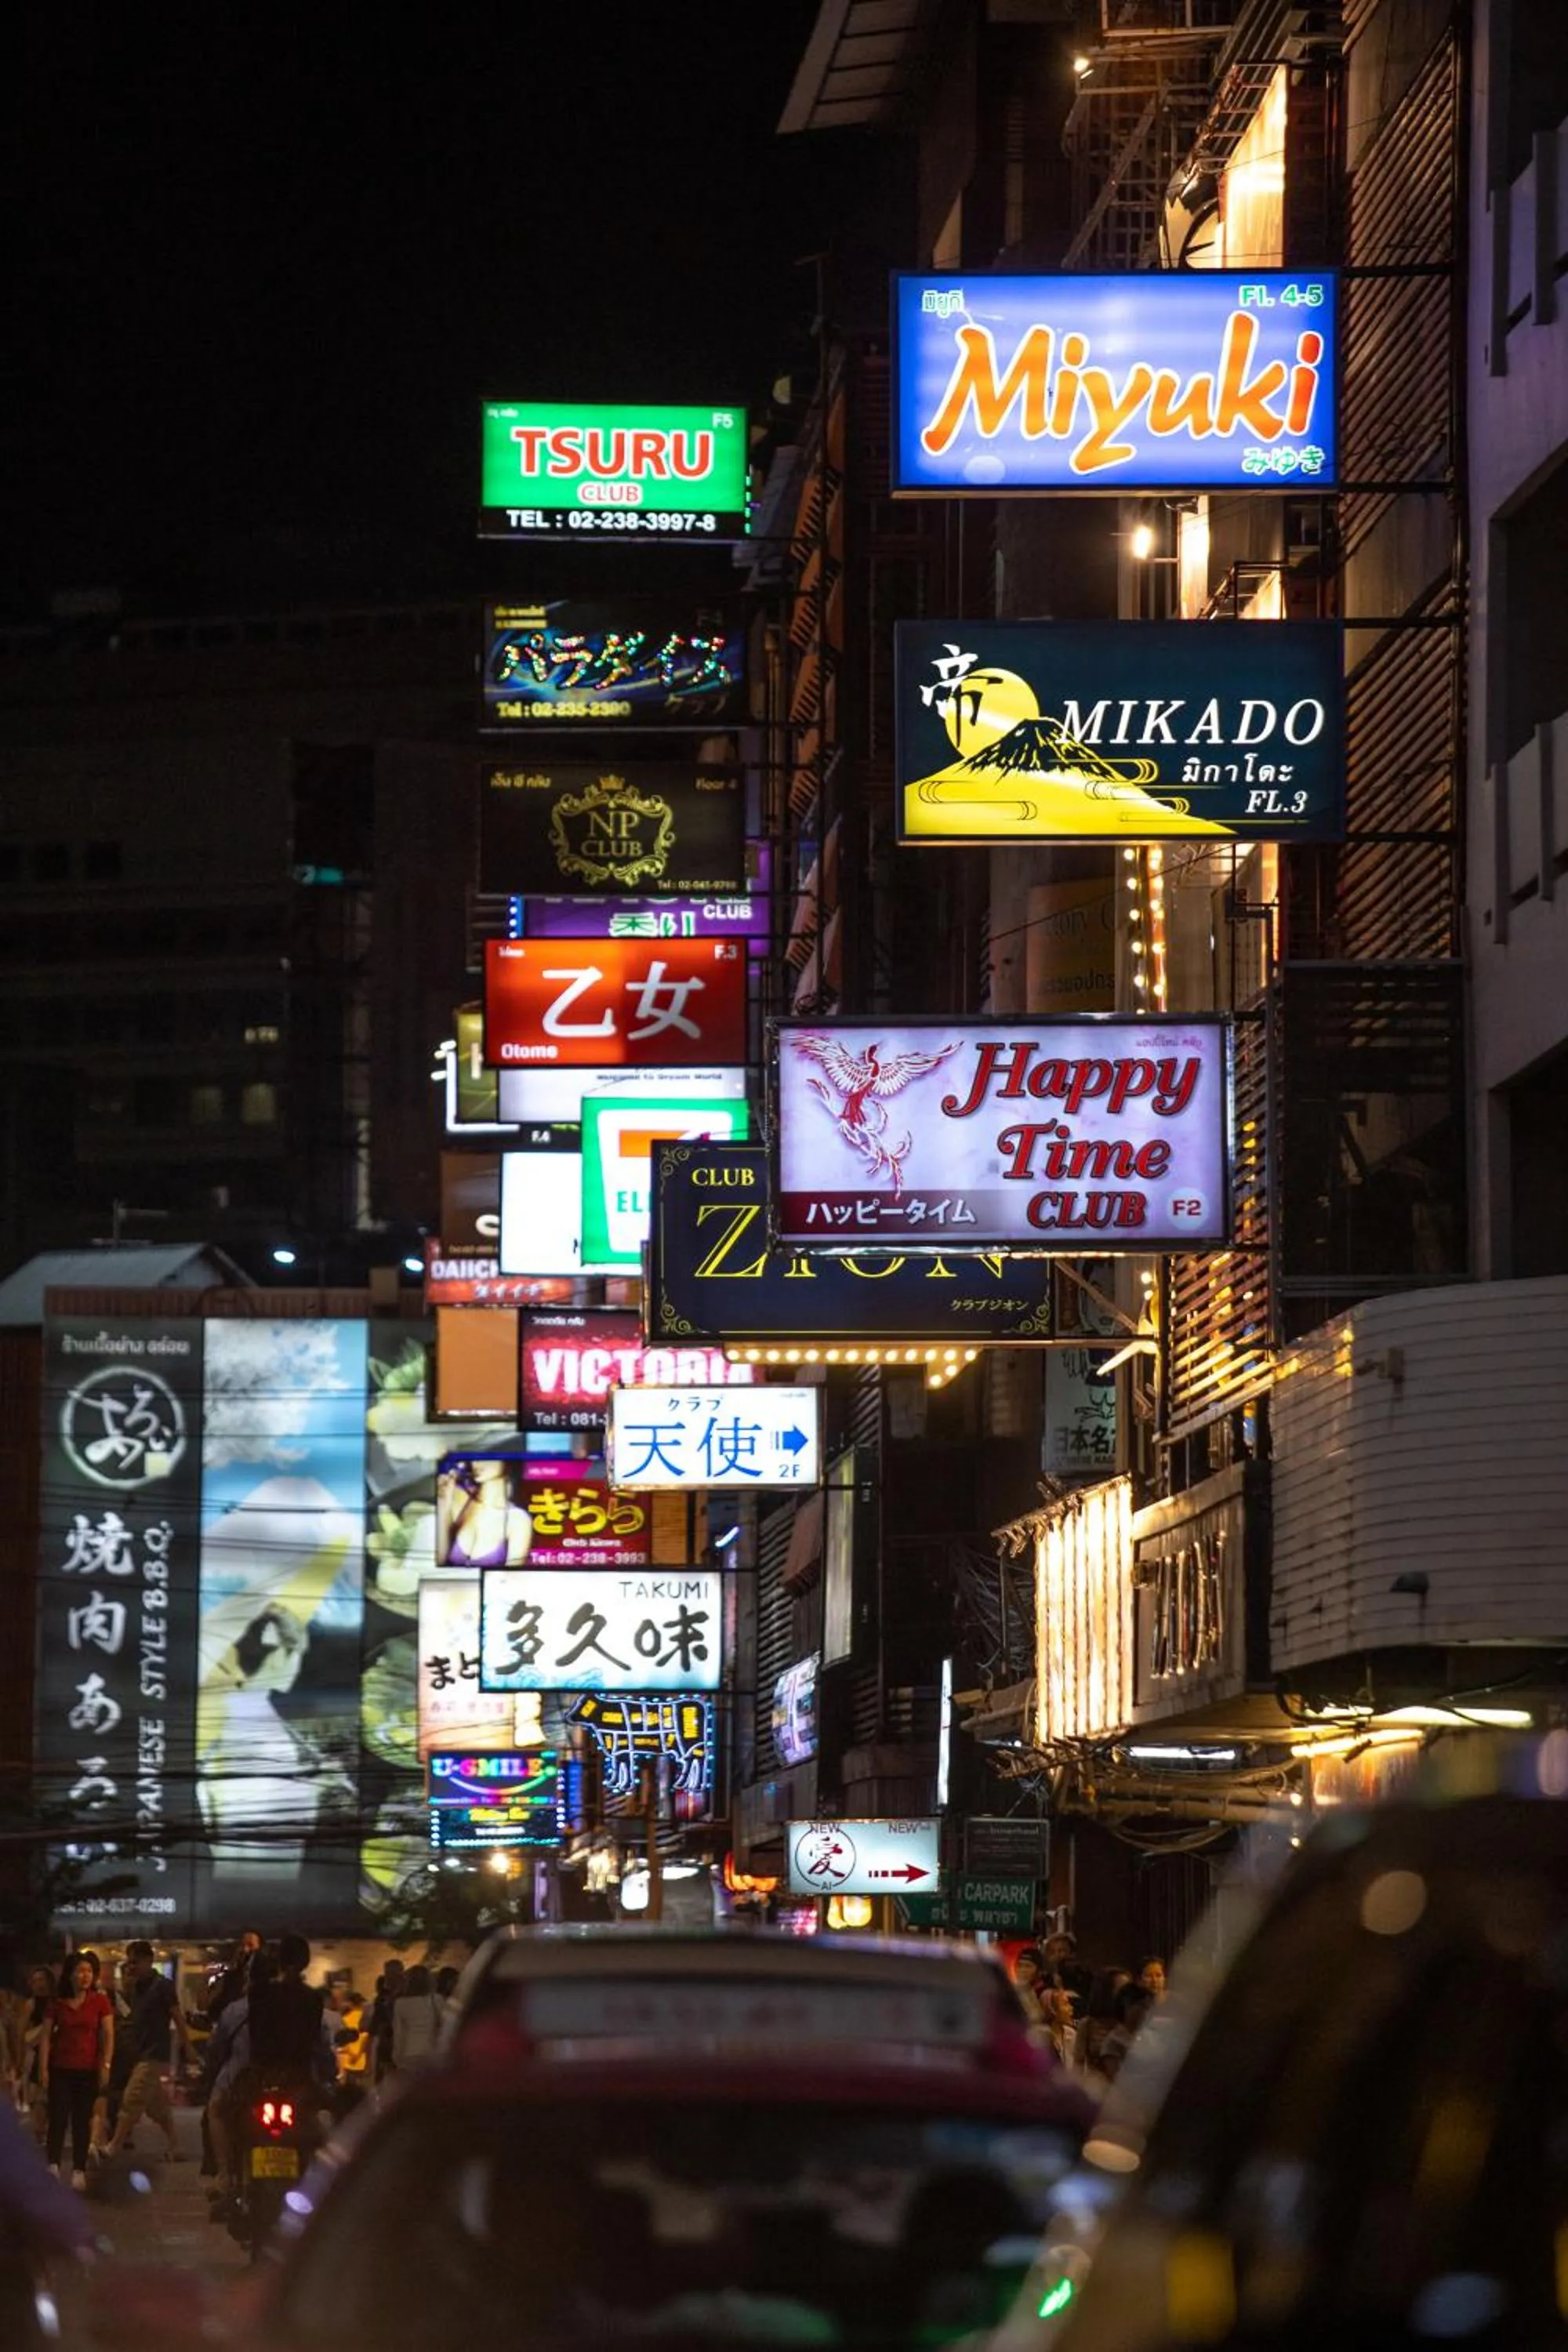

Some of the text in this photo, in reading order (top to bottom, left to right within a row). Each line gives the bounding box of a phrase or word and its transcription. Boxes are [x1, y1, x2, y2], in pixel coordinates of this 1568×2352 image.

[1281, 284, 1323, 307] 4-5
[921, 311, 1323, 476] Miyuki
[712, 413, 734, 429] F5
[510, 426, 714, 484] TSURU
[1242, 447, 1324, 474] みゆき
[579, 482, 641, 504] CLUB
[506, 510, 550, 528] TEL
[568, 511, 716, 532] 02-238-3997-8
[919, 644, 1004, 748] 帝
[1054, 699, 1325, 746] MIKADO
[1182, 753, 1294, 783] มิกาโดะ
[1245, 790, 1308, 814] FL.3
[589, 811, 641, 839] NP
[581, 840, 644, 858] CLUB
[702, 904, 753, 919] CLUB
[714, 944, 738, 960] F.3
[542, 960, 705, 1041] 乙女
[500, 1044, 558, 1059] Otome
[941, 1042, 1202, 1119] Happy
[997, 1117, 1171, 1181] Time
[691, 1168, 756, 1188] CLUB
[617, 1191, 652, 1213] EL
[806, 1199, 976, 1225] ハッピータイム
[1026, 1190, 1149, 1229] CLUB
[1172, 1200, 1201, 1216] F2
[950, 1299, 1029, 1312] クラブジオン
[668, 1394, 725, 1411] クラブ
[533, 1412, 557, 1425] Tel
[622, 1417, 764, 1479] 天使
[1054, 1424, 1115, 1454] 日本名
[779, 1465, 800, 1479] 2F
[528, 1487, 645, 1535] きらら
[619, 1581, 710, 1599] TAKUMI
[495, 1599, 710, 1675] 多久味
[140, 1616, 167, 1700] STYLE
[810, 1823, 840, 1834] NEW
[888, 1823, 917, 1835] NEW
[821, 1881, 833, 1890] AI
[964, 1883, 1029, 1905] CARPARK
